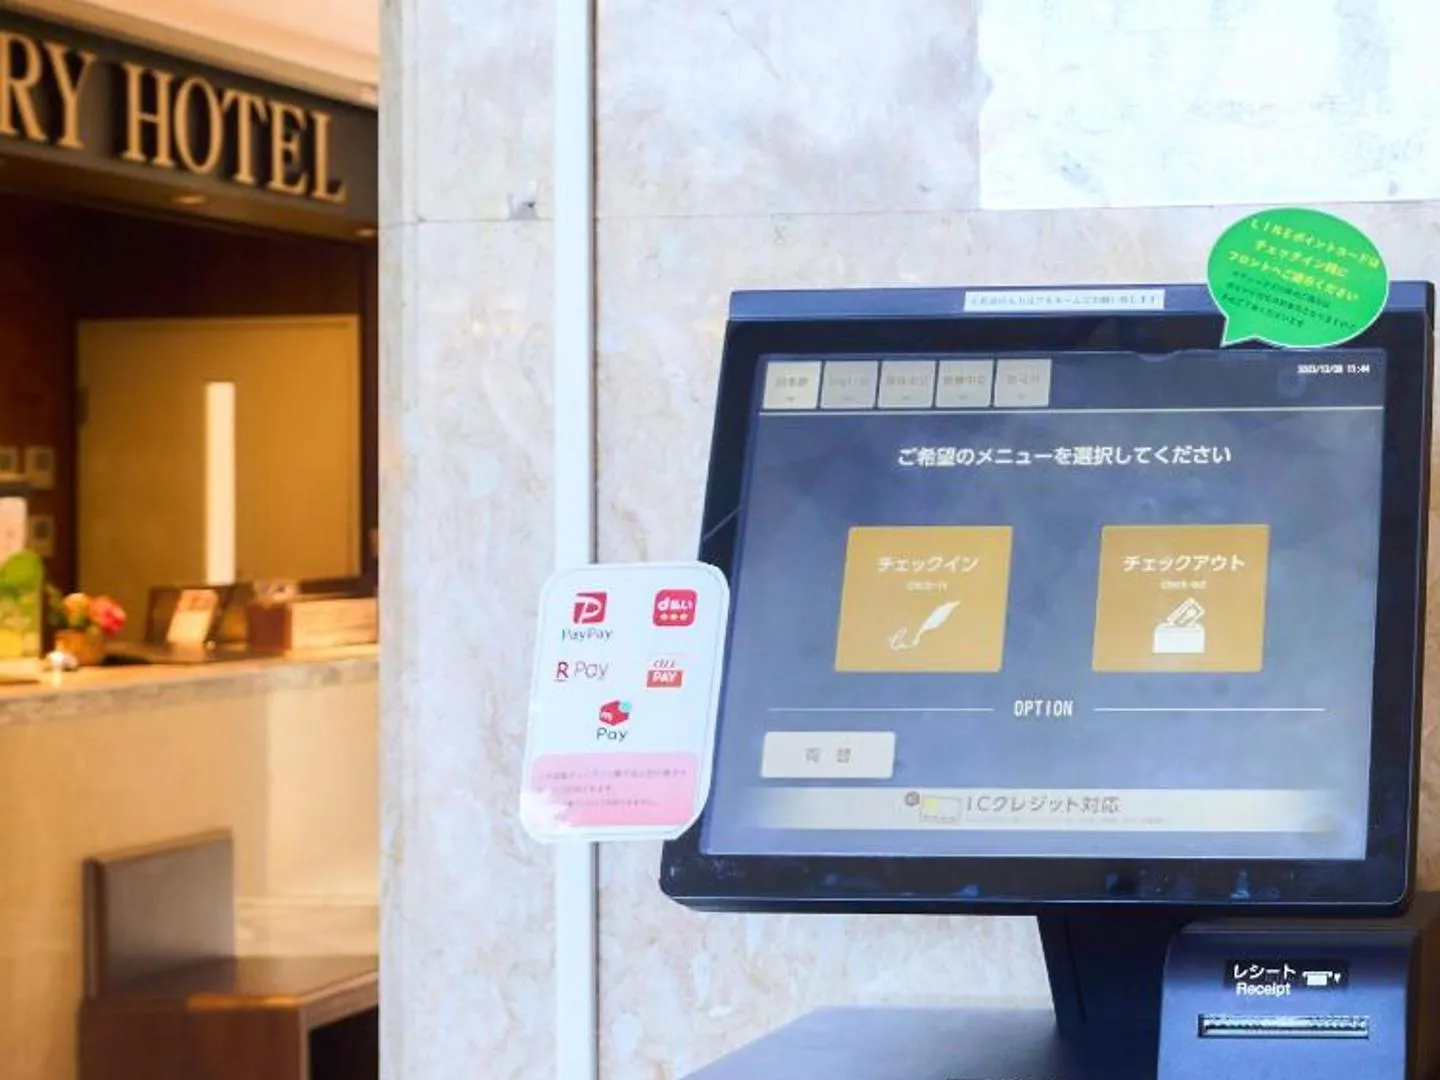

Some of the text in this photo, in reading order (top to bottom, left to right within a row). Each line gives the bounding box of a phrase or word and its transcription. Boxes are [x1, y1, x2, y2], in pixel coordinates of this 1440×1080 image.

[121, 61, 347, 203] HOTEL
[897, 445, 1232, 467] ご希望のメニューを選択してください
[876, 555, 980, 573] チェックイン
[1122, 554, 1246, 573] チェックアウト
[561, 626, 613, 643] PayPay
[1013, 699, 1074, 718] OPTION
[596, 727, 628, 743] Pay
[966, 795, 1122, 814] ICクレジット対応
[1233, 963, 1296, 979] レシート
[1235, 982, 1291, 997] Receipt
